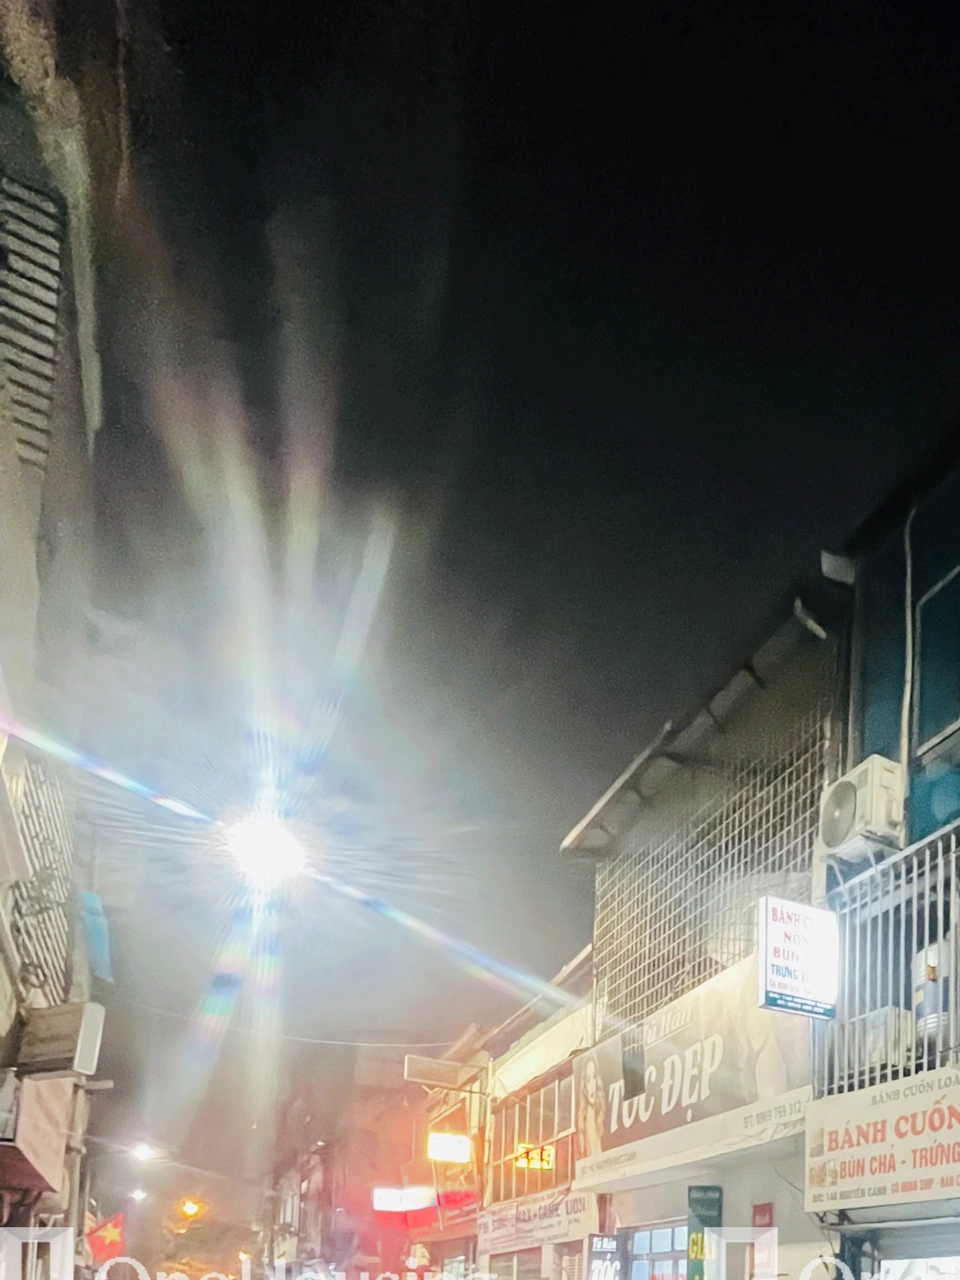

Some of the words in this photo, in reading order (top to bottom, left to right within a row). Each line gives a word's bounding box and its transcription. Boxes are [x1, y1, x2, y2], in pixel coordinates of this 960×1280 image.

[660, 1033, 724, 1123] ĐẸP
[827, 1119, 887, 1152] BÁNH
[839, 1155, 865, 1179] BÚN
[869, 1144, 896, 1175] CHẢ
